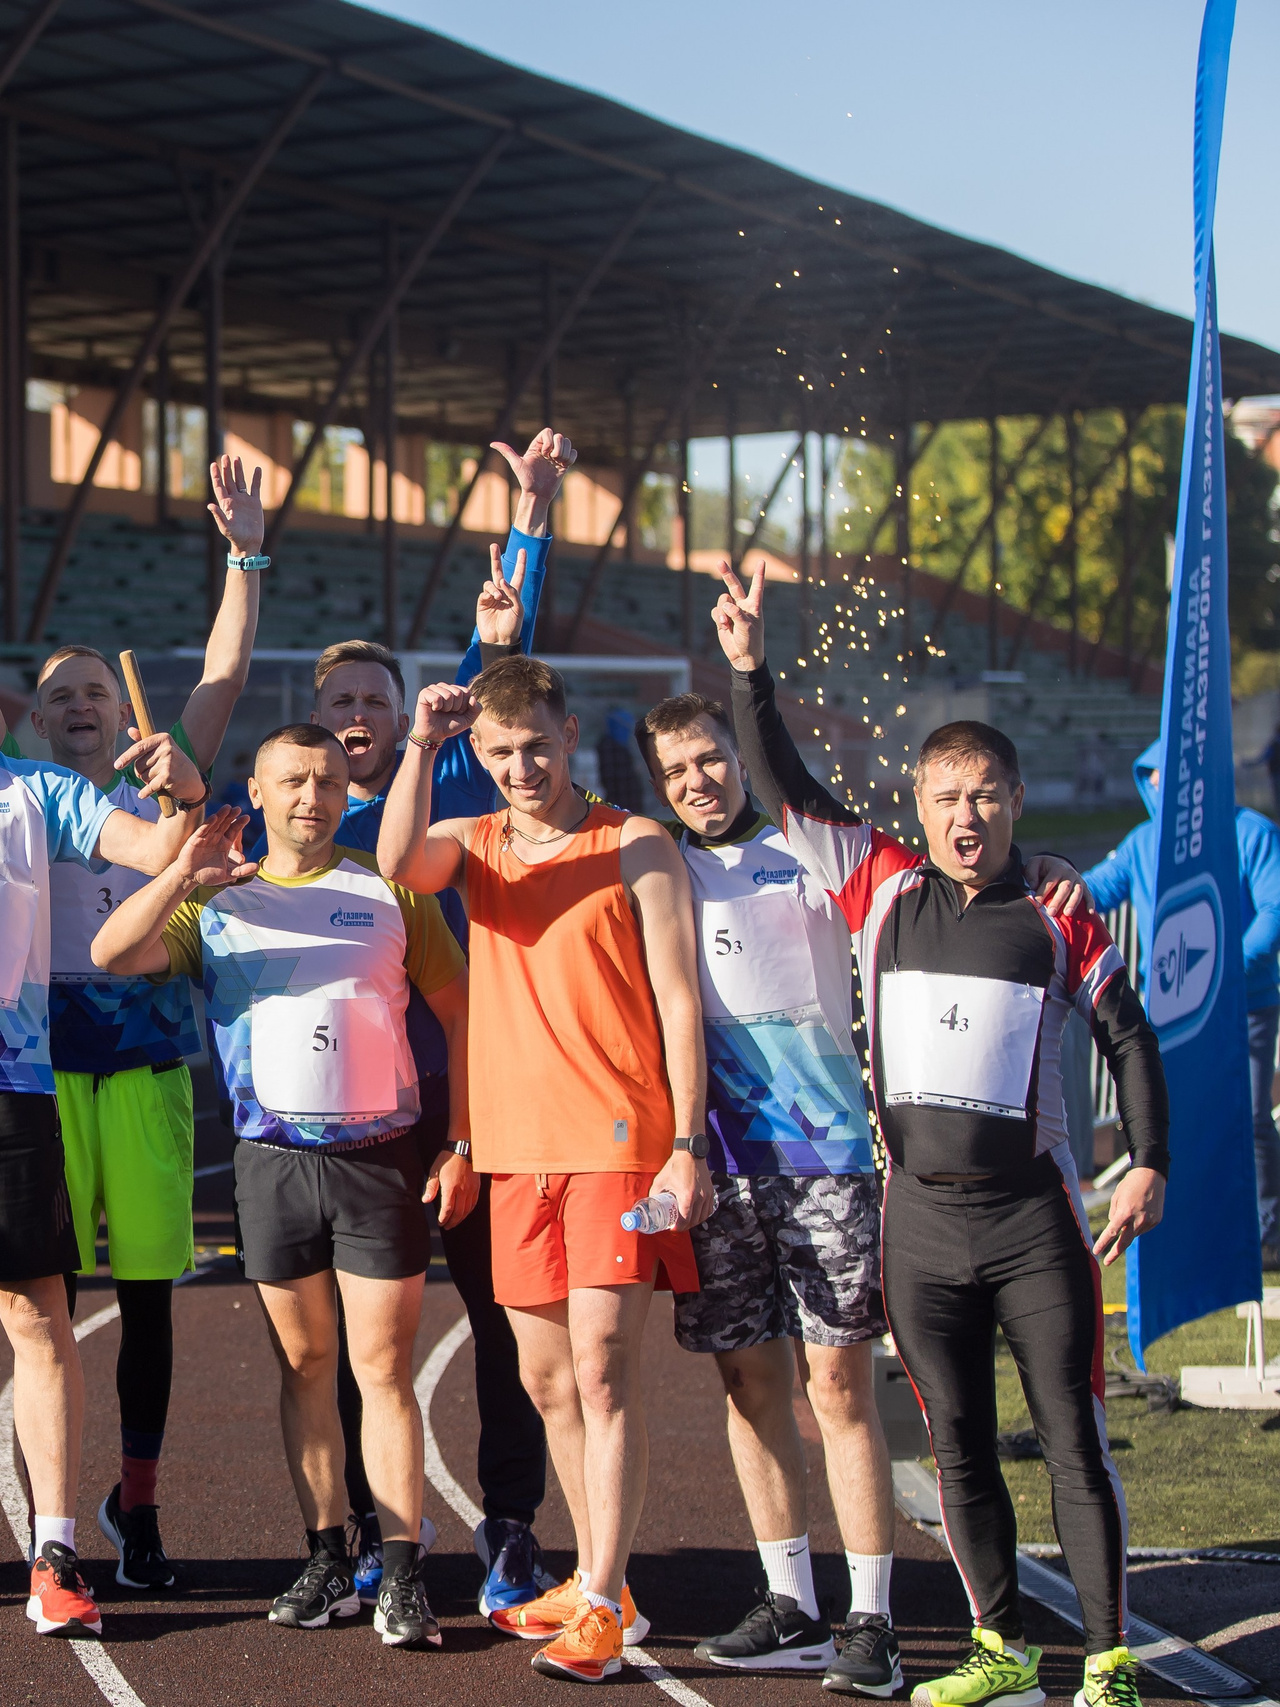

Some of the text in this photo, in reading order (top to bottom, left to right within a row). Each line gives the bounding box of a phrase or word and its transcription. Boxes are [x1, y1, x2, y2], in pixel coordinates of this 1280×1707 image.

[1174, 566, 1201, 865] СПАРТАКИАДА
[1197, 554, 1212, 766] «ГАЗПРОМ
[1190, 777, 1205, 858] ООО
[343, 912, 374, 921] ГАЗПРОМ
